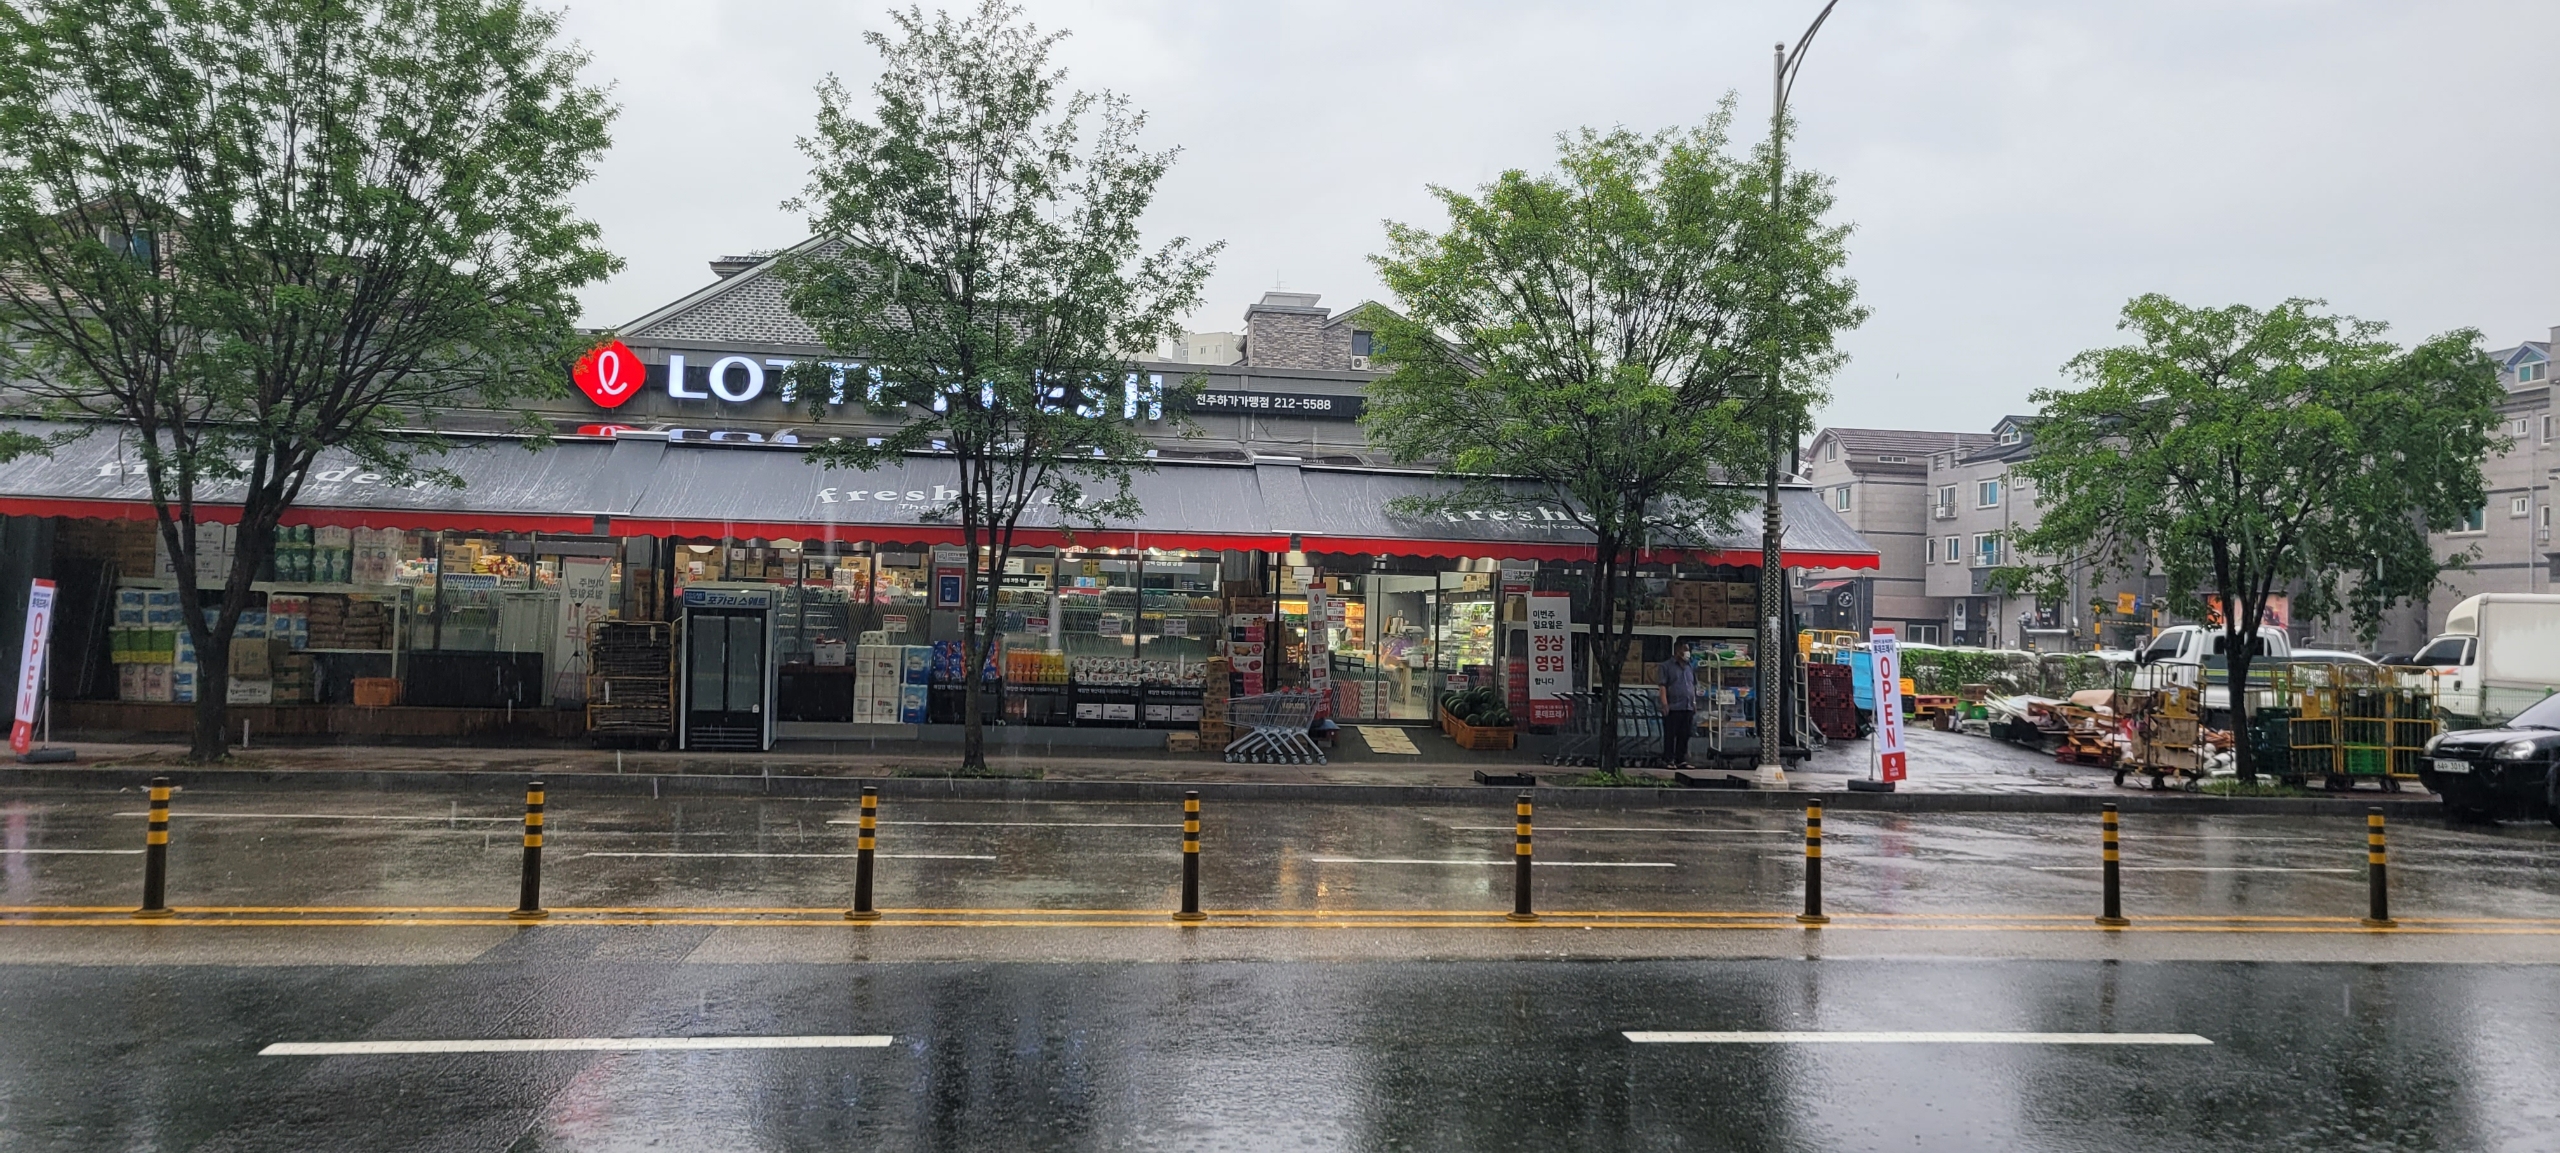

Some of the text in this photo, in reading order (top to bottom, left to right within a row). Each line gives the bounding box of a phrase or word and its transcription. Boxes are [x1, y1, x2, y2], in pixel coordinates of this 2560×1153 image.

[668, 354, 907, 408] LOTTE
[1195, 394, 1332, 410] 전주하가가맹점 212-5588
[817, 484, 960, 504] fresh
[1441, 506, 1572, 523] fresh
[707, 596, 767, 606] 포카리 스웨트
[1532, 610, 1555, 620] 이번주
[1532, 620, 1564, 630] 일요일은
[1534, 634, 1565, 652] 정상
[22, 612, 43, 716] OPEN
[1535, 655, 1564, 672] 영업
[1534, 677, 1555, 685] 합니다
[1880, 656, 1897, 749] OPEN
